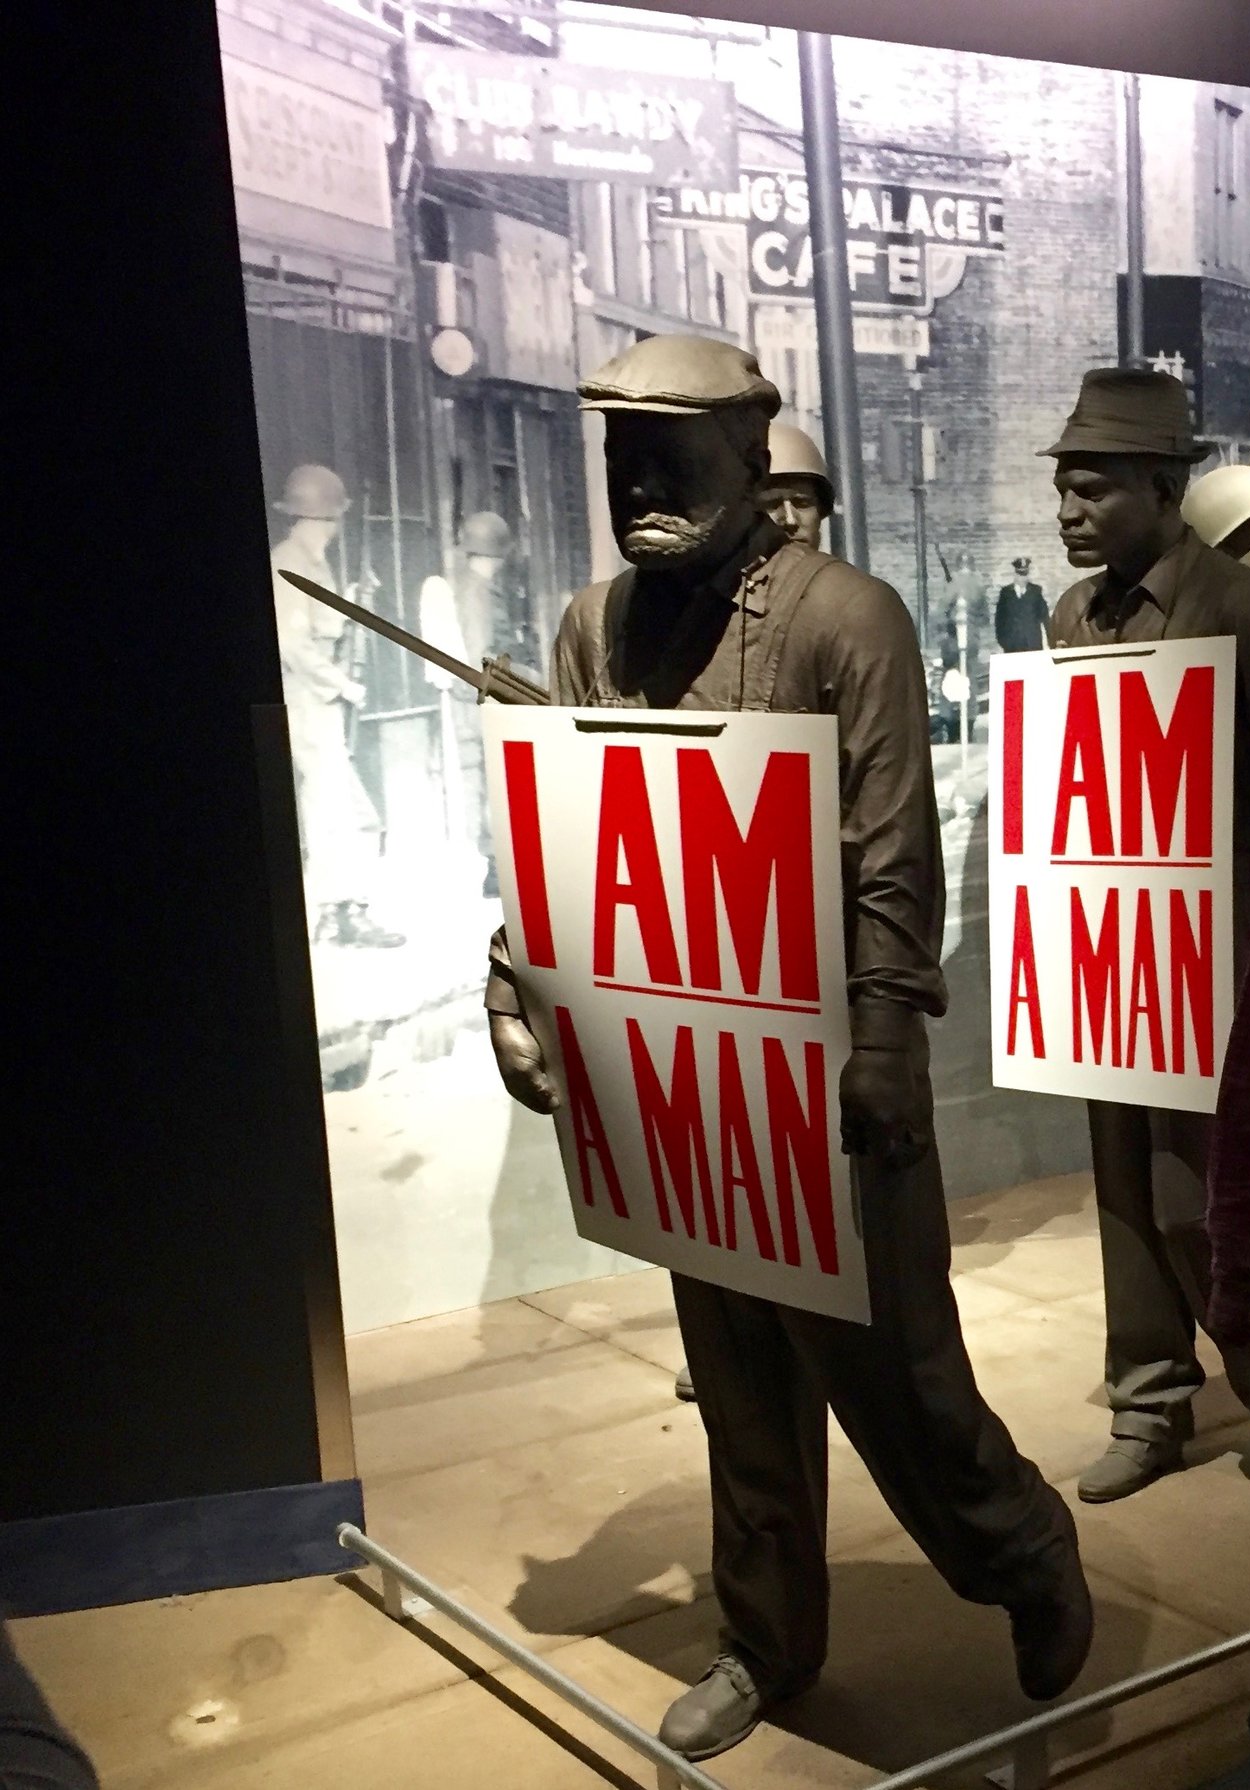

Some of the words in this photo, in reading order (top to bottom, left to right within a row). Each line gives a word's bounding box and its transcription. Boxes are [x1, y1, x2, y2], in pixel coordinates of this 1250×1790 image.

[502, 740, 558, 970] I
[593, 744, 821, 1003] AM
[1003, 679, 1024, 855] I
[1050, 666, 1215, 858] AM
[1006, 885, 1047, 1060] A
[1070, 886, 1215, 1078] MAN
[555, 1005, 631, 1220] A
[625, 1017, 840, 1277] MAN
